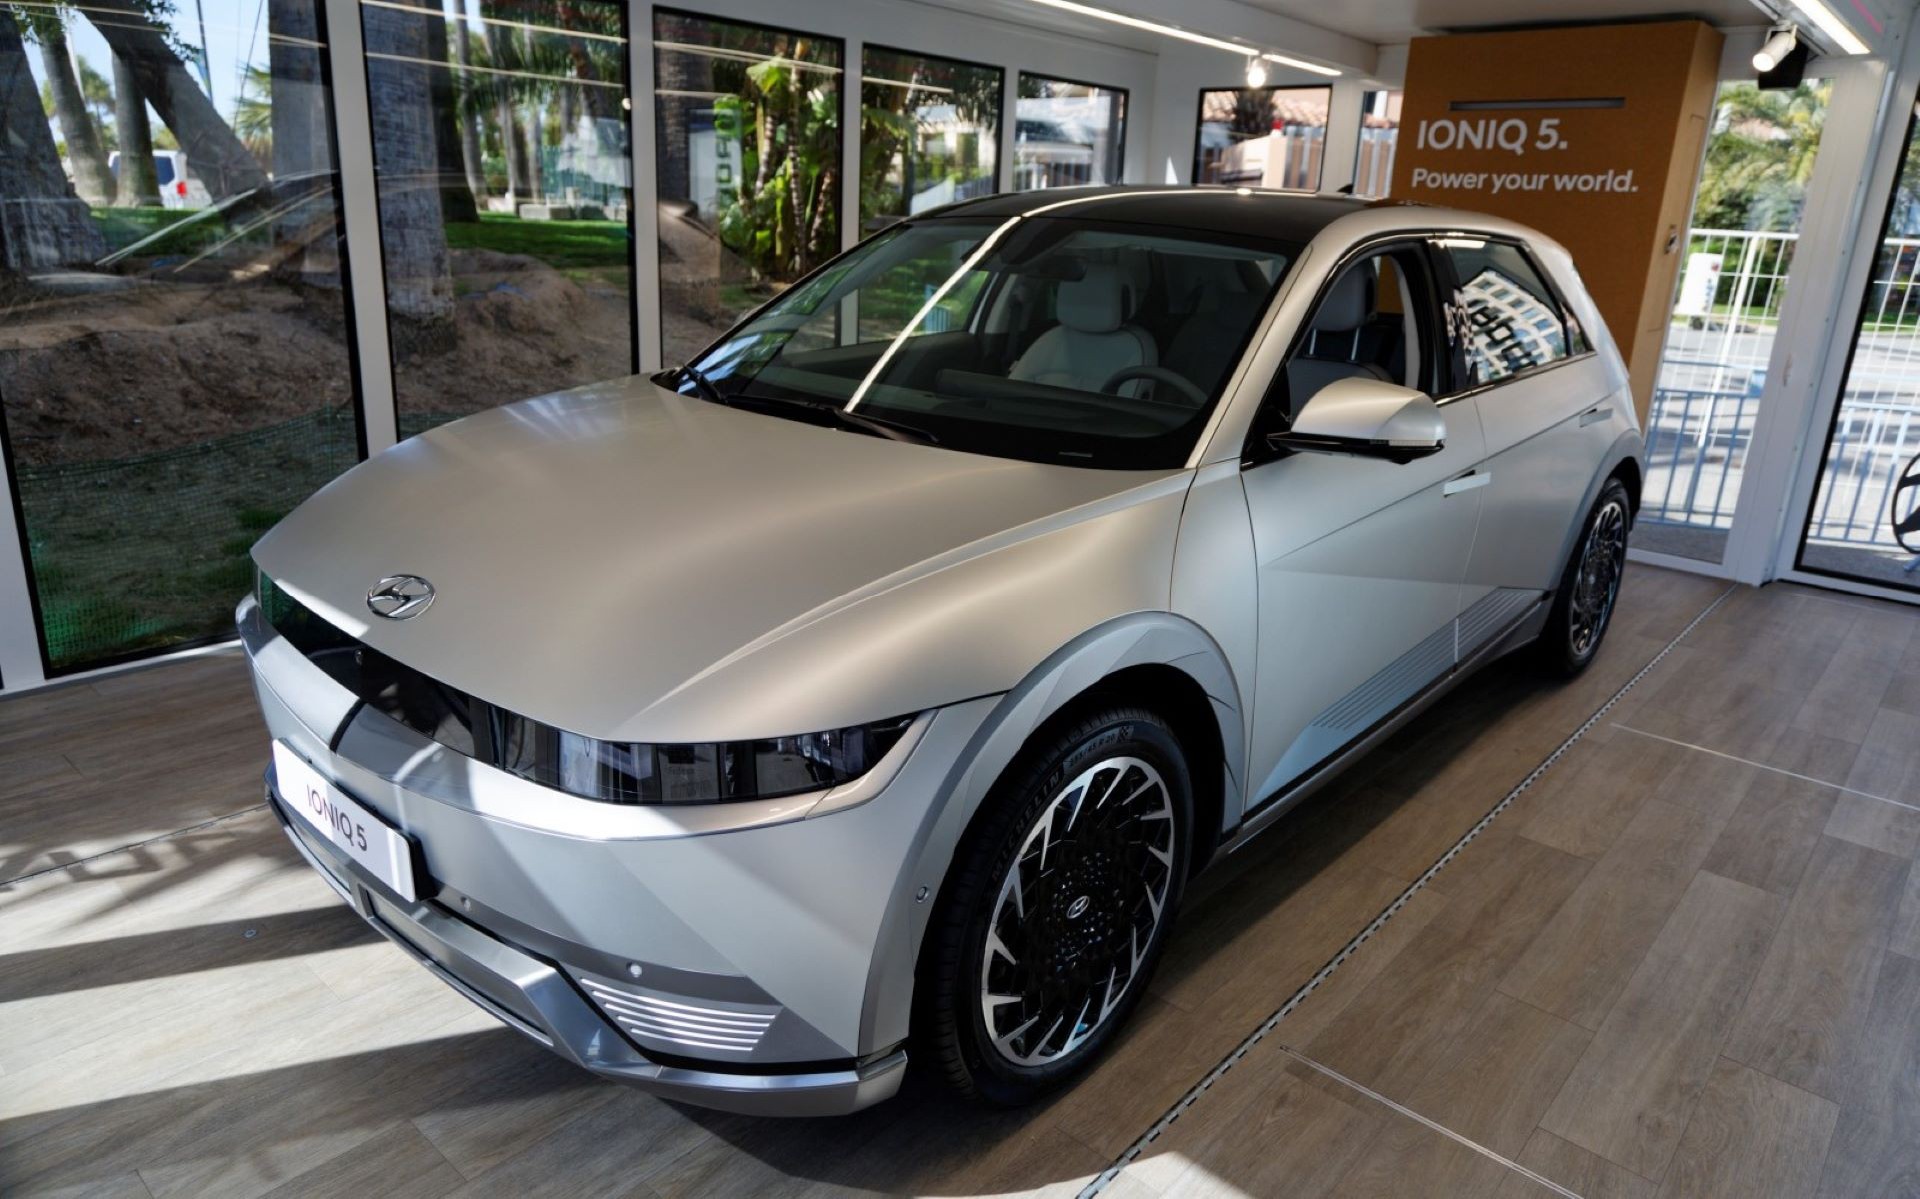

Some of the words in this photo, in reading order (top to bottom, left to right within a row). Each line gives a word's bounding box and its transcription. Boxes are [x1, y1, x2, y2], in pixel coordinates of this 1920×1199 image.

[1416, 118, 1528, 156] IONIQ
[1535, 118, 1568, 150] 5.
[1411, 168, 1488, 190] Power
[1491, 172, 1549, 194] your
[1553, 169, 1638, 193] world.
[306, 784, 355, 847] IONIQ
[356, 823, 368, 852] 5
[992, 771, 1061, 881] MICHELIN
